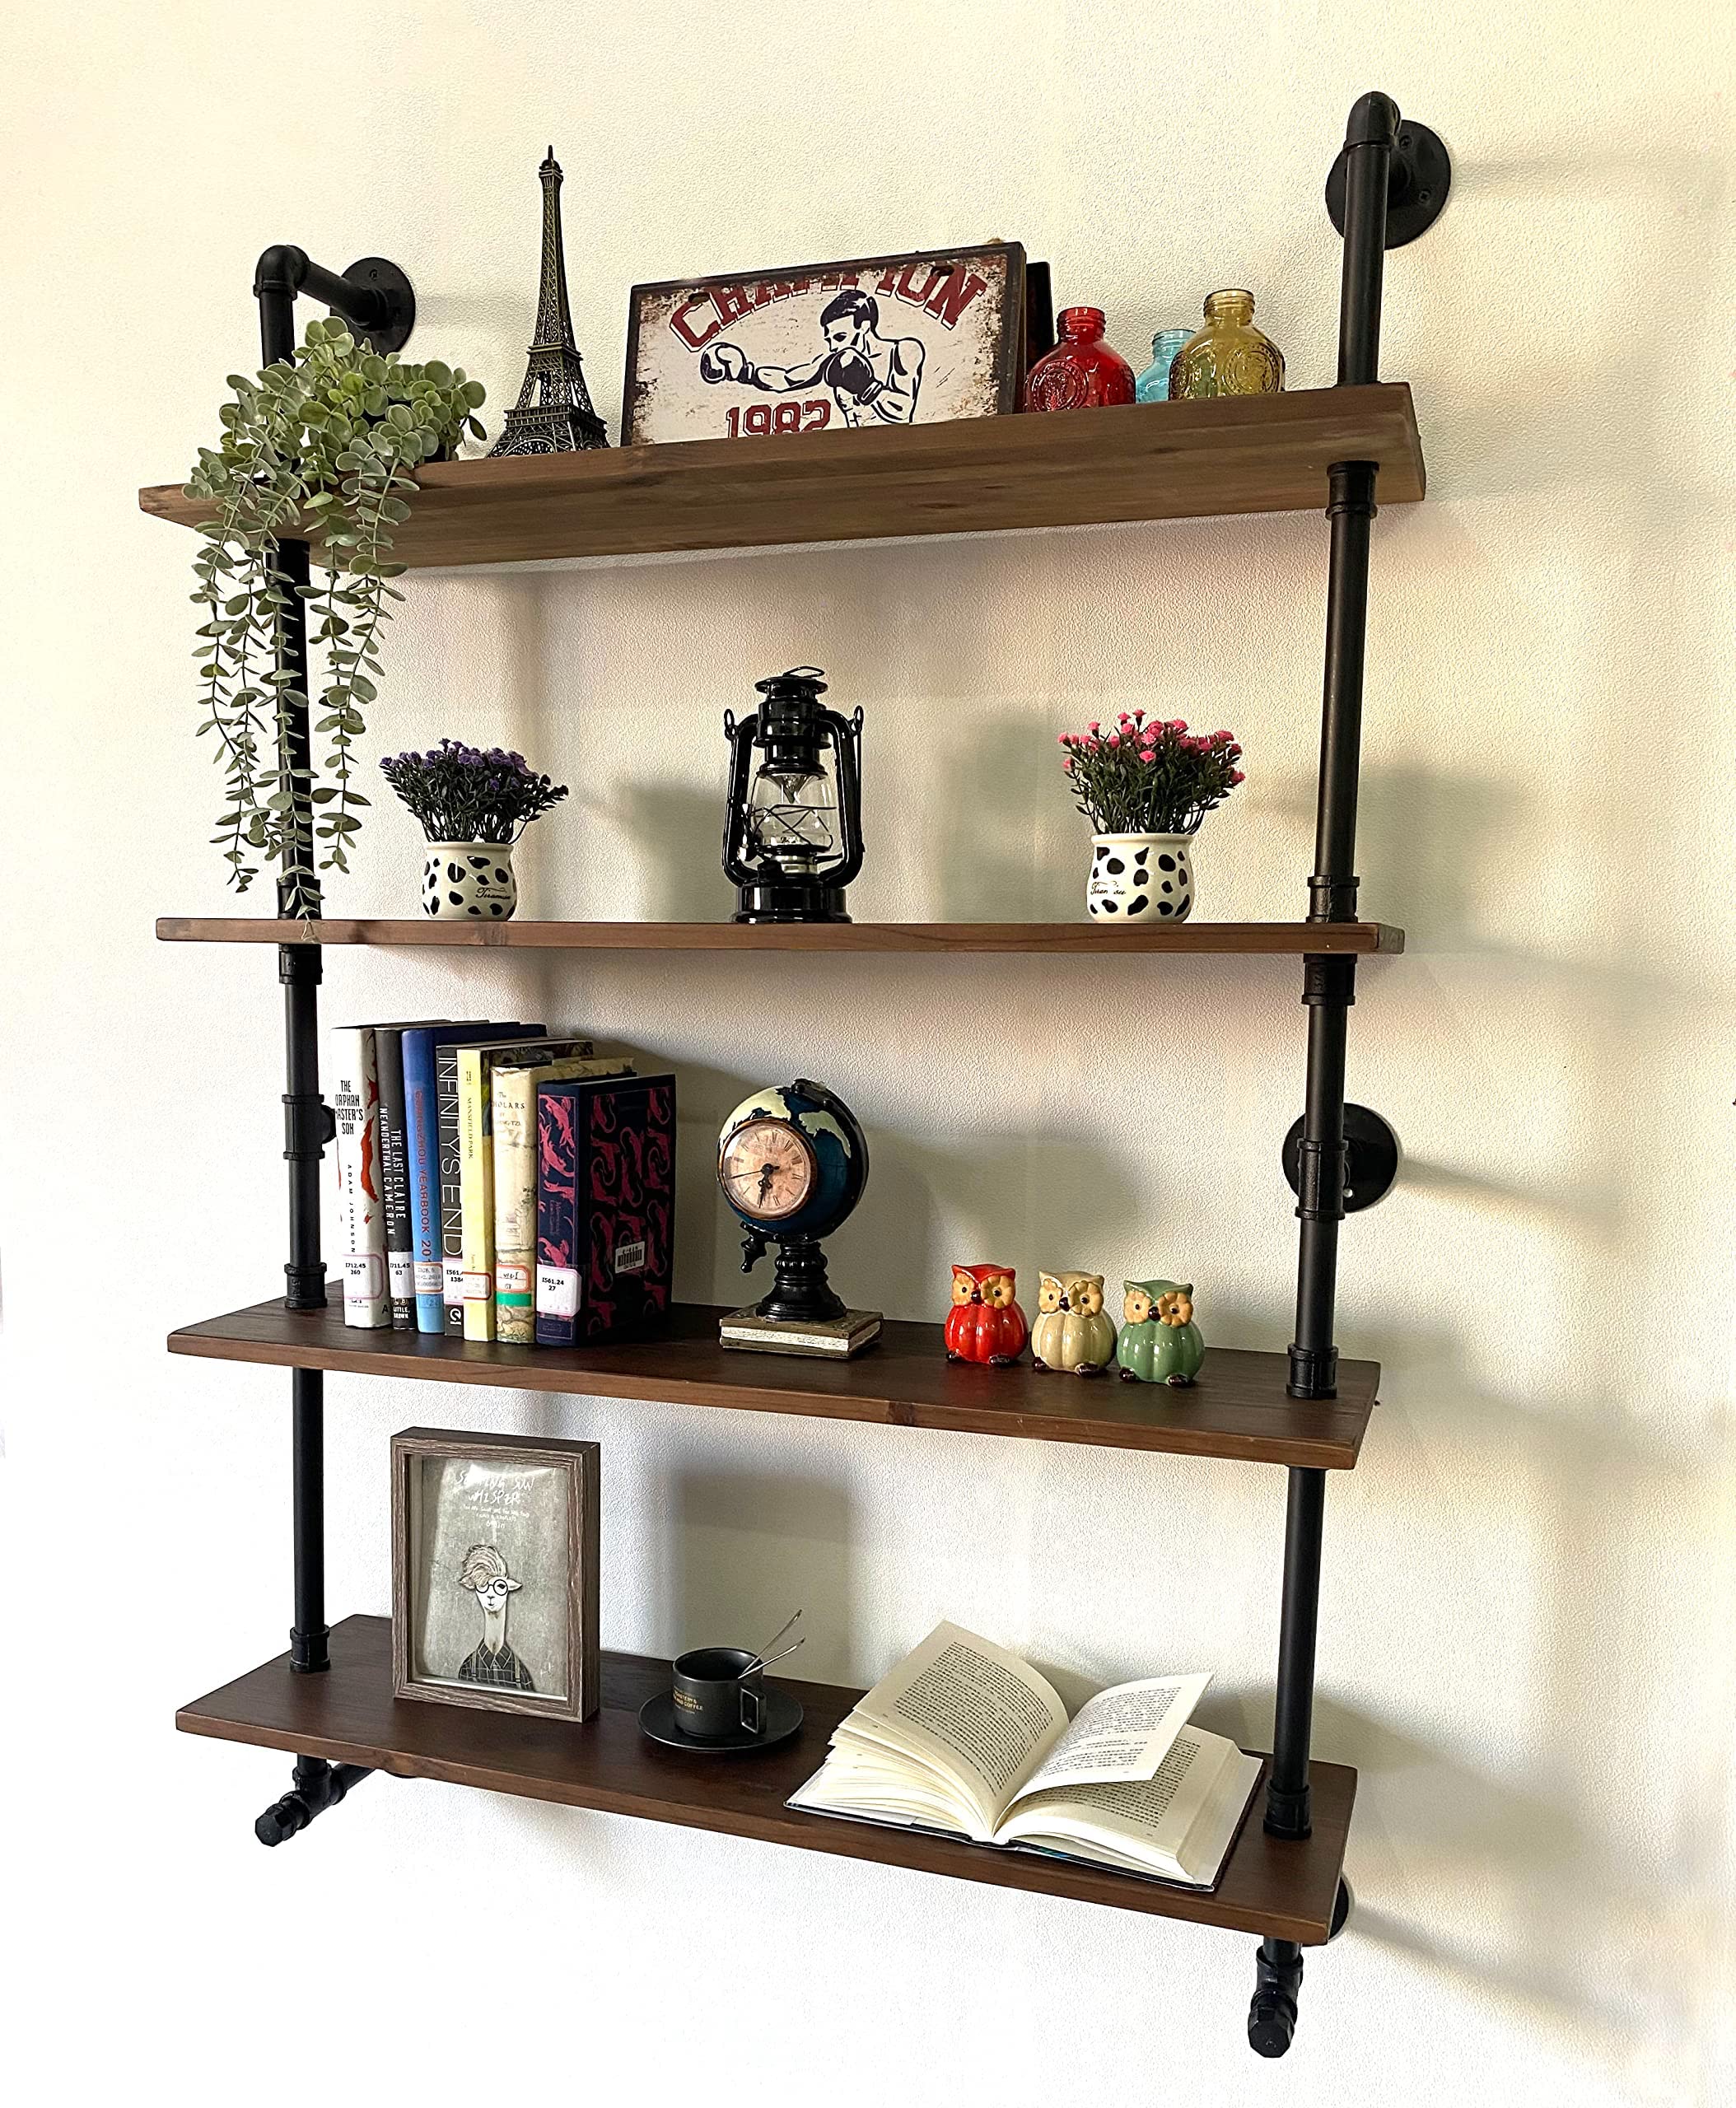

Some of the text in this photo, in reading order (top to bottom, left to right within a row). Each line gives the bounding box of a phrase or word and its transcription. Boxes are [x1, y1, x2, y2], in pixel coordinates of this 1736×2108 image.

[670, 264, 988, 352] CHION
[726, 399, 832, 439] 1982
[335, 1093, 360, 1108] ORPHAN
[340, 1080, 352, 1093] THE
[335, 1108, 364, 1122] ASTER'S
[342, 1122, 354, 1136] SON
[380, 1108, 396, 1235] NEANDERTHAL CAMERON
[390, 1130, 406, 1220] THE LAST CLAIRE
[419, 1169, 431, 1234] YEARBOOK
[442, 1184, 463, 1257] END
